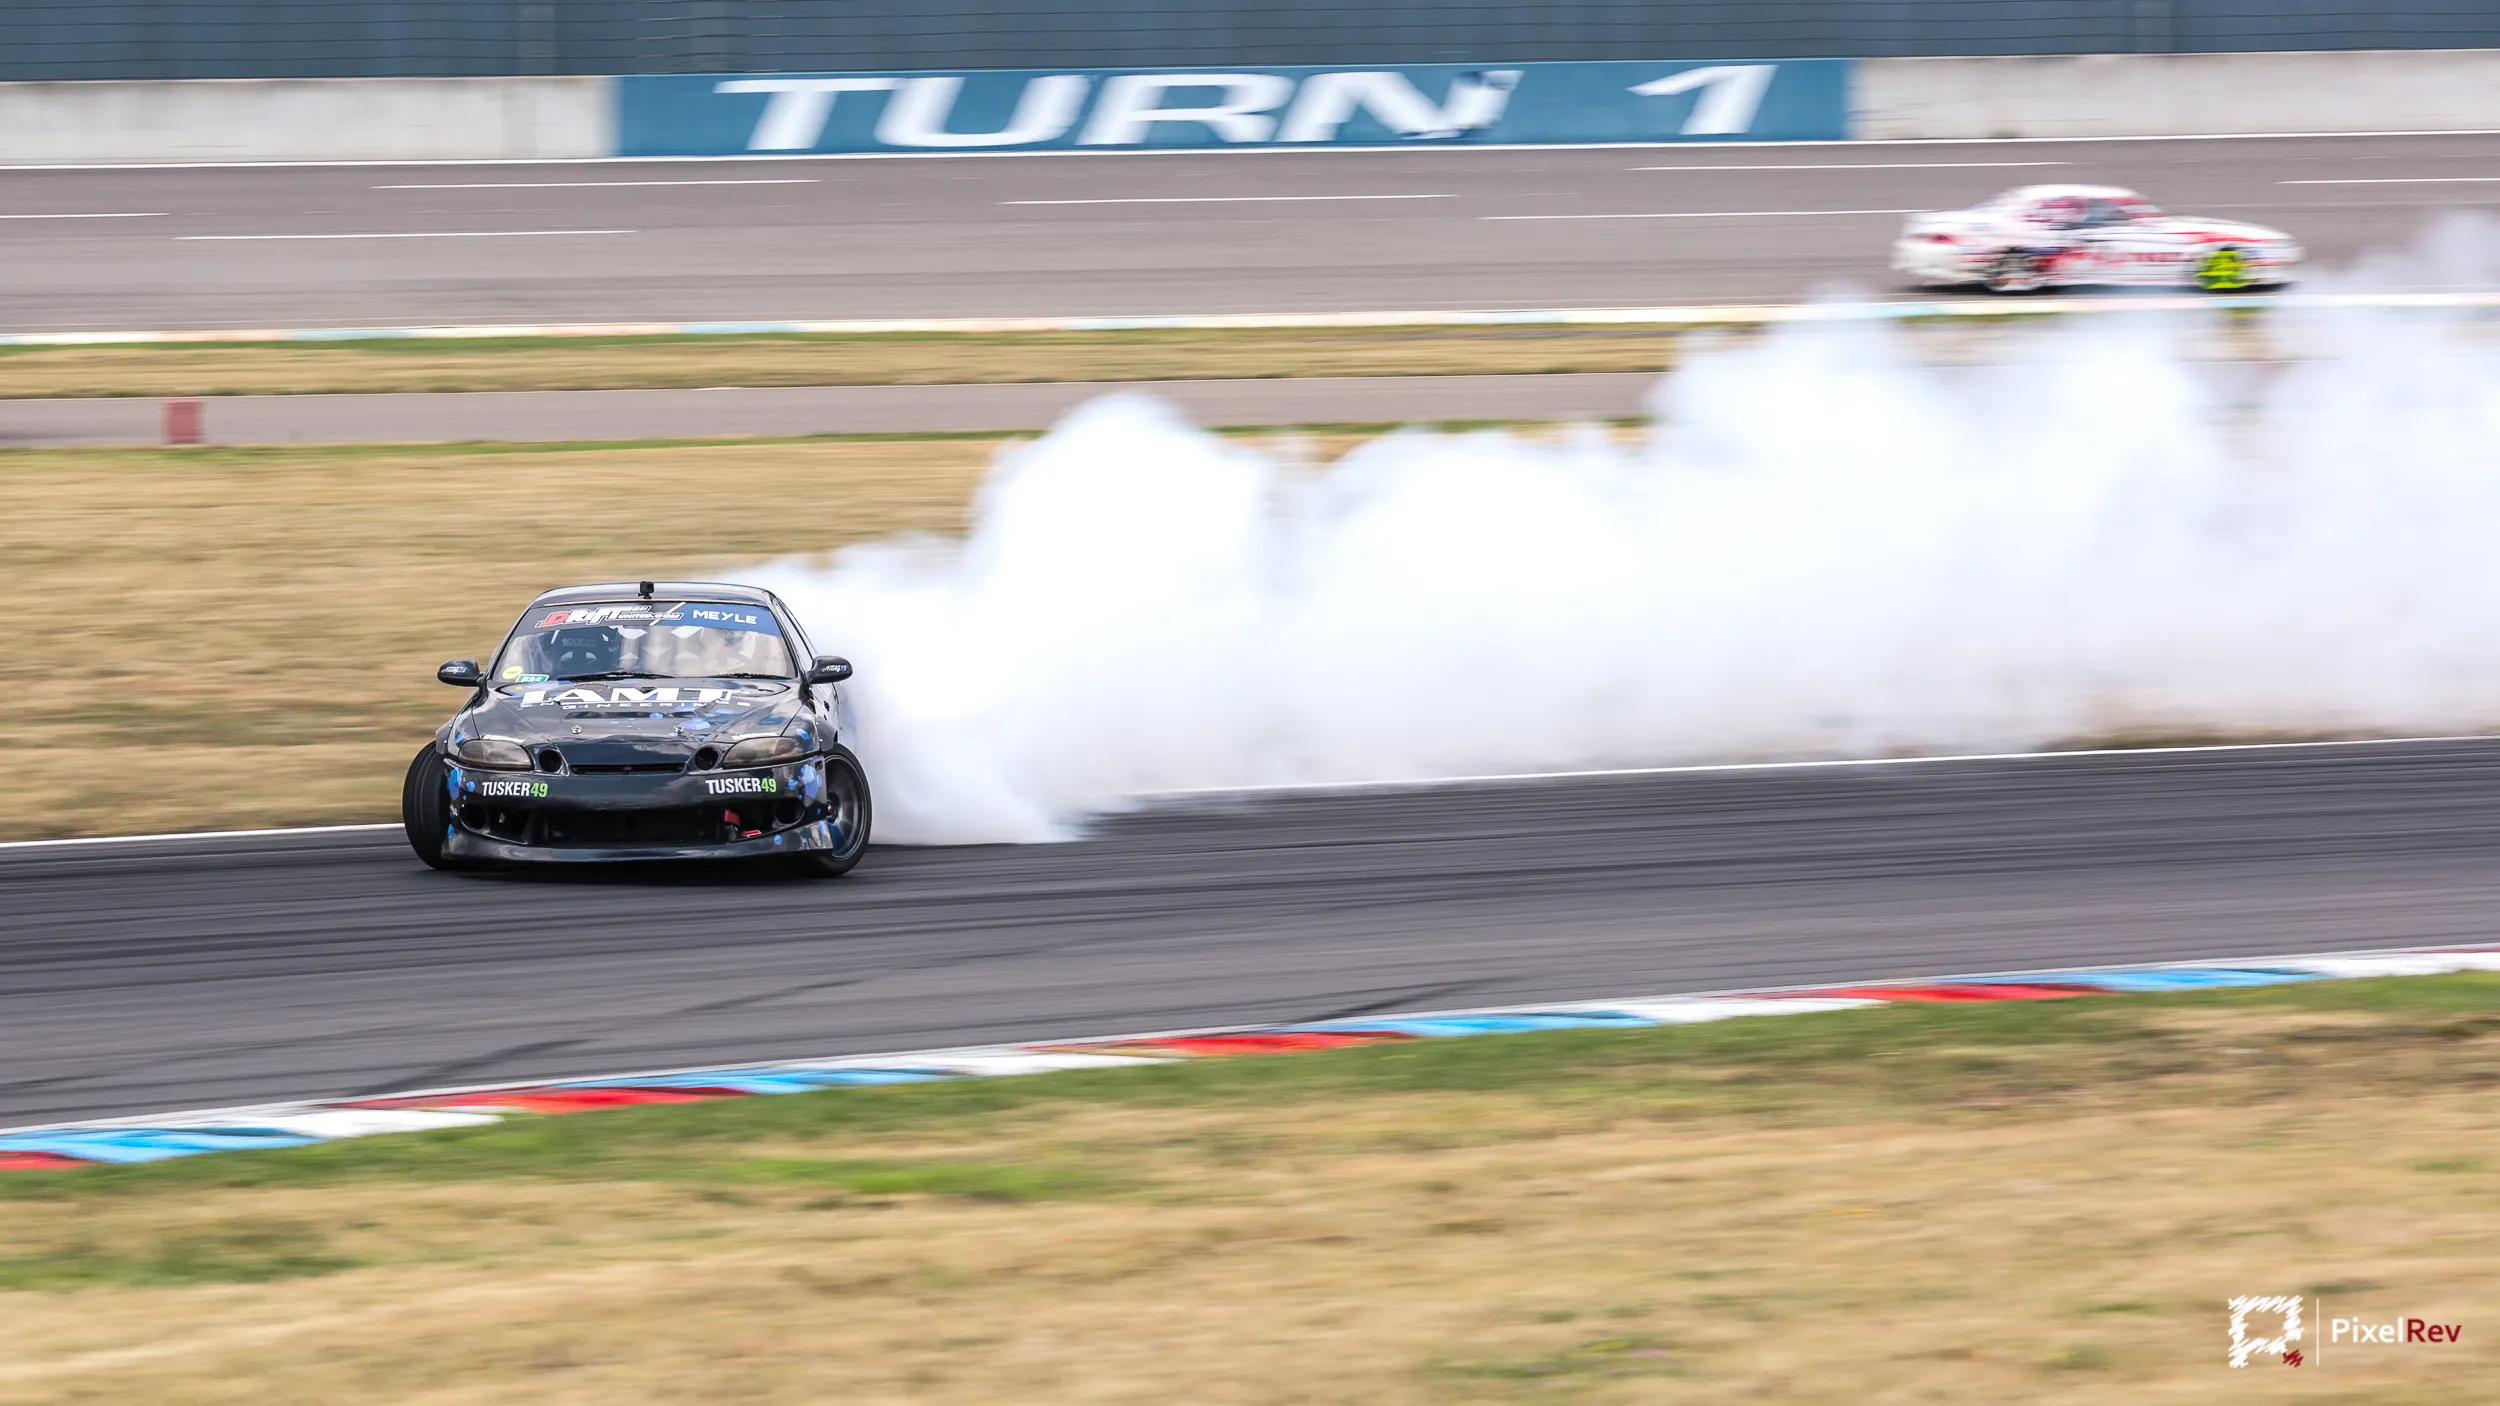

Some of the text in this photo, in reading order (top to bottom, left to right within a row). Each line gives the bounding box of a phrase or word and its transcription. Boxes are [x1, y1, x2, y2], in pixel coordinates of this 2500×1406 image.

[713, 64, 1780, 150] TURN 1
[537, 607, 631, 626] DRIFT
[692, 610, 758, 625] MEYLE
[482, 781, 549, 798] TUSKER49
[705, 777, 777, 795] TUSKER49
